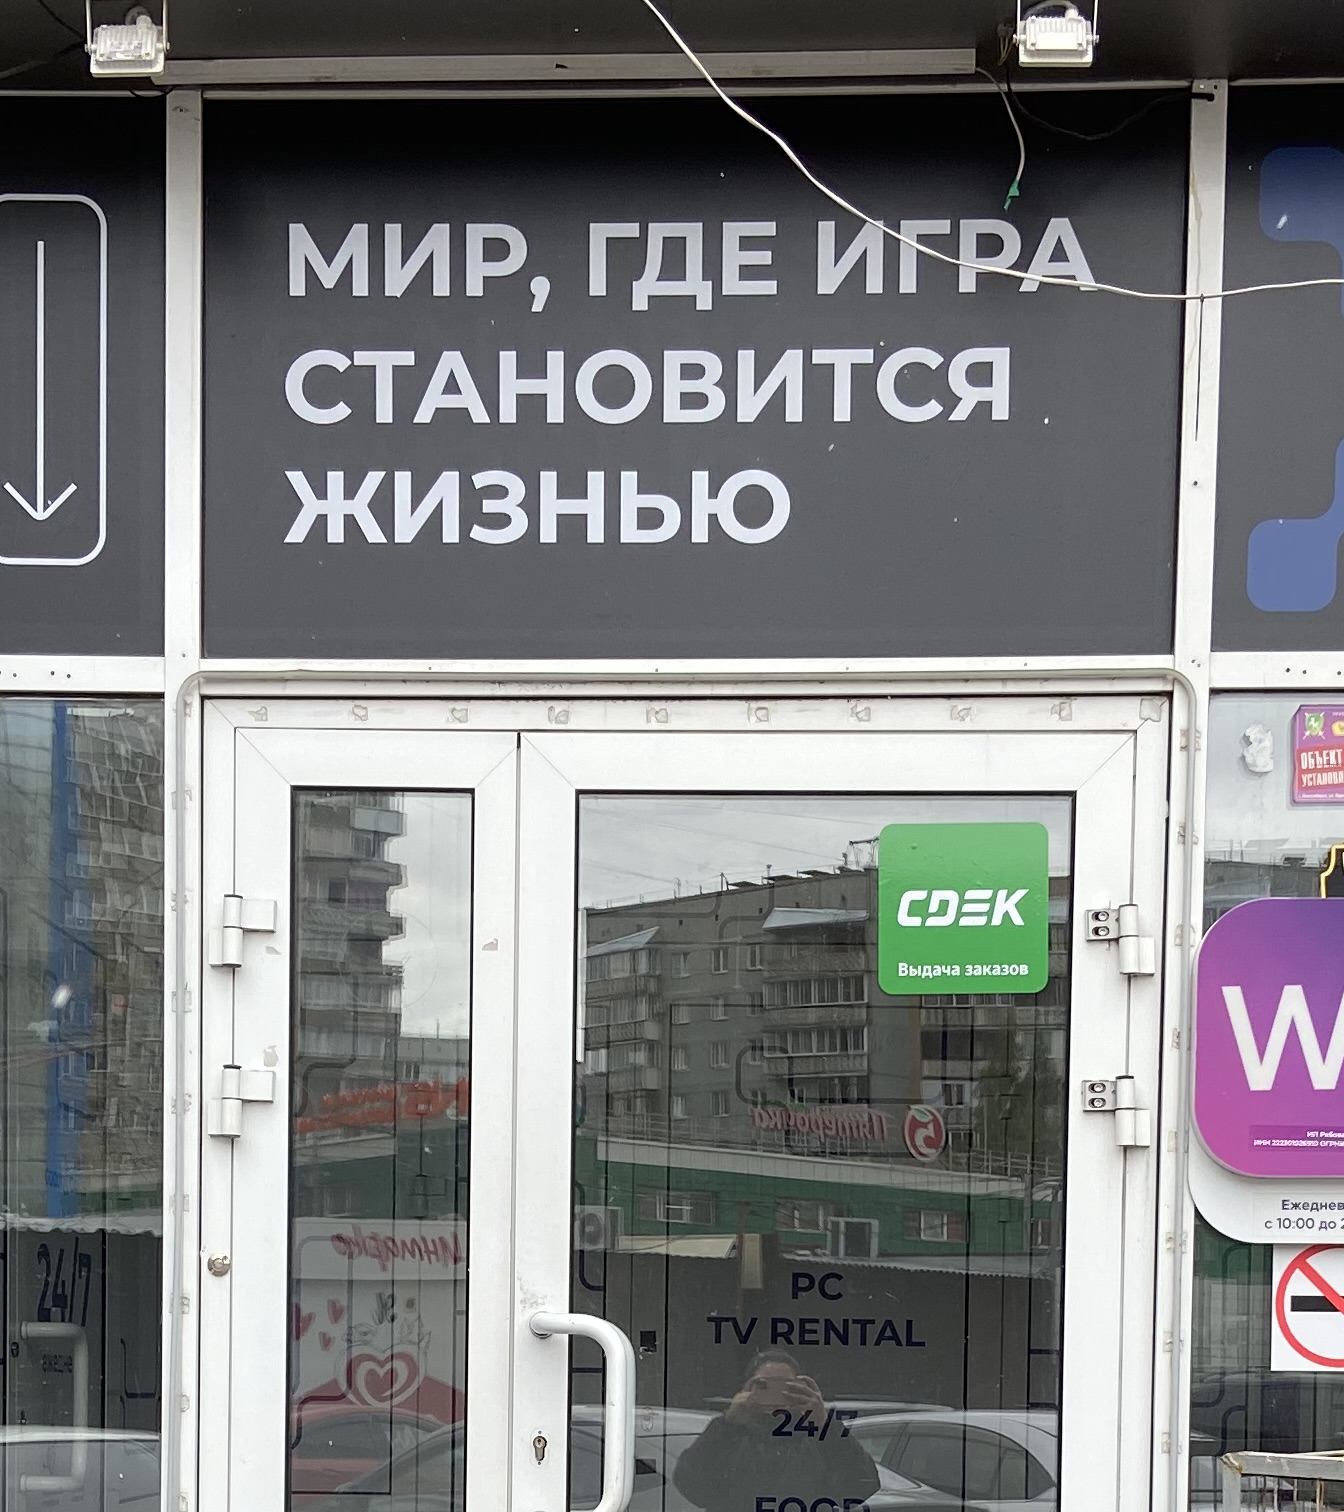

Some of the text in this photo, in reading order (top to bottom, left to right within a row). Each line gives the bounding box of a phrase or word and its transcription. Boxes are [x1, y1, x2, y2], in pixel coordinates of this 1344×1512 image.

[287, 217, 1098, 312] МИР, ГДЕ ИГРА
[284, 346, 1012, 426] СТАНОВИТСЯ
[283, 468, 792, 546] ЖИЗНЬЮ
[1300, 748, 1343, 770] ОБЪЕКТ
[897, 888, 1030, 927] CDEK
[897, 962, 1029, 979] Выдача заказов
[1264, 1218, 1273, 1229] с
[1277, 1217, 1315, 1230] 10:00
[1318, 1218, 1337, 1231] до
[791, 1272, 844, 1301] PC
[707, 1316, 926, 1348] TV RENTAL
[771, 1408, 858, 1442] 24/7
